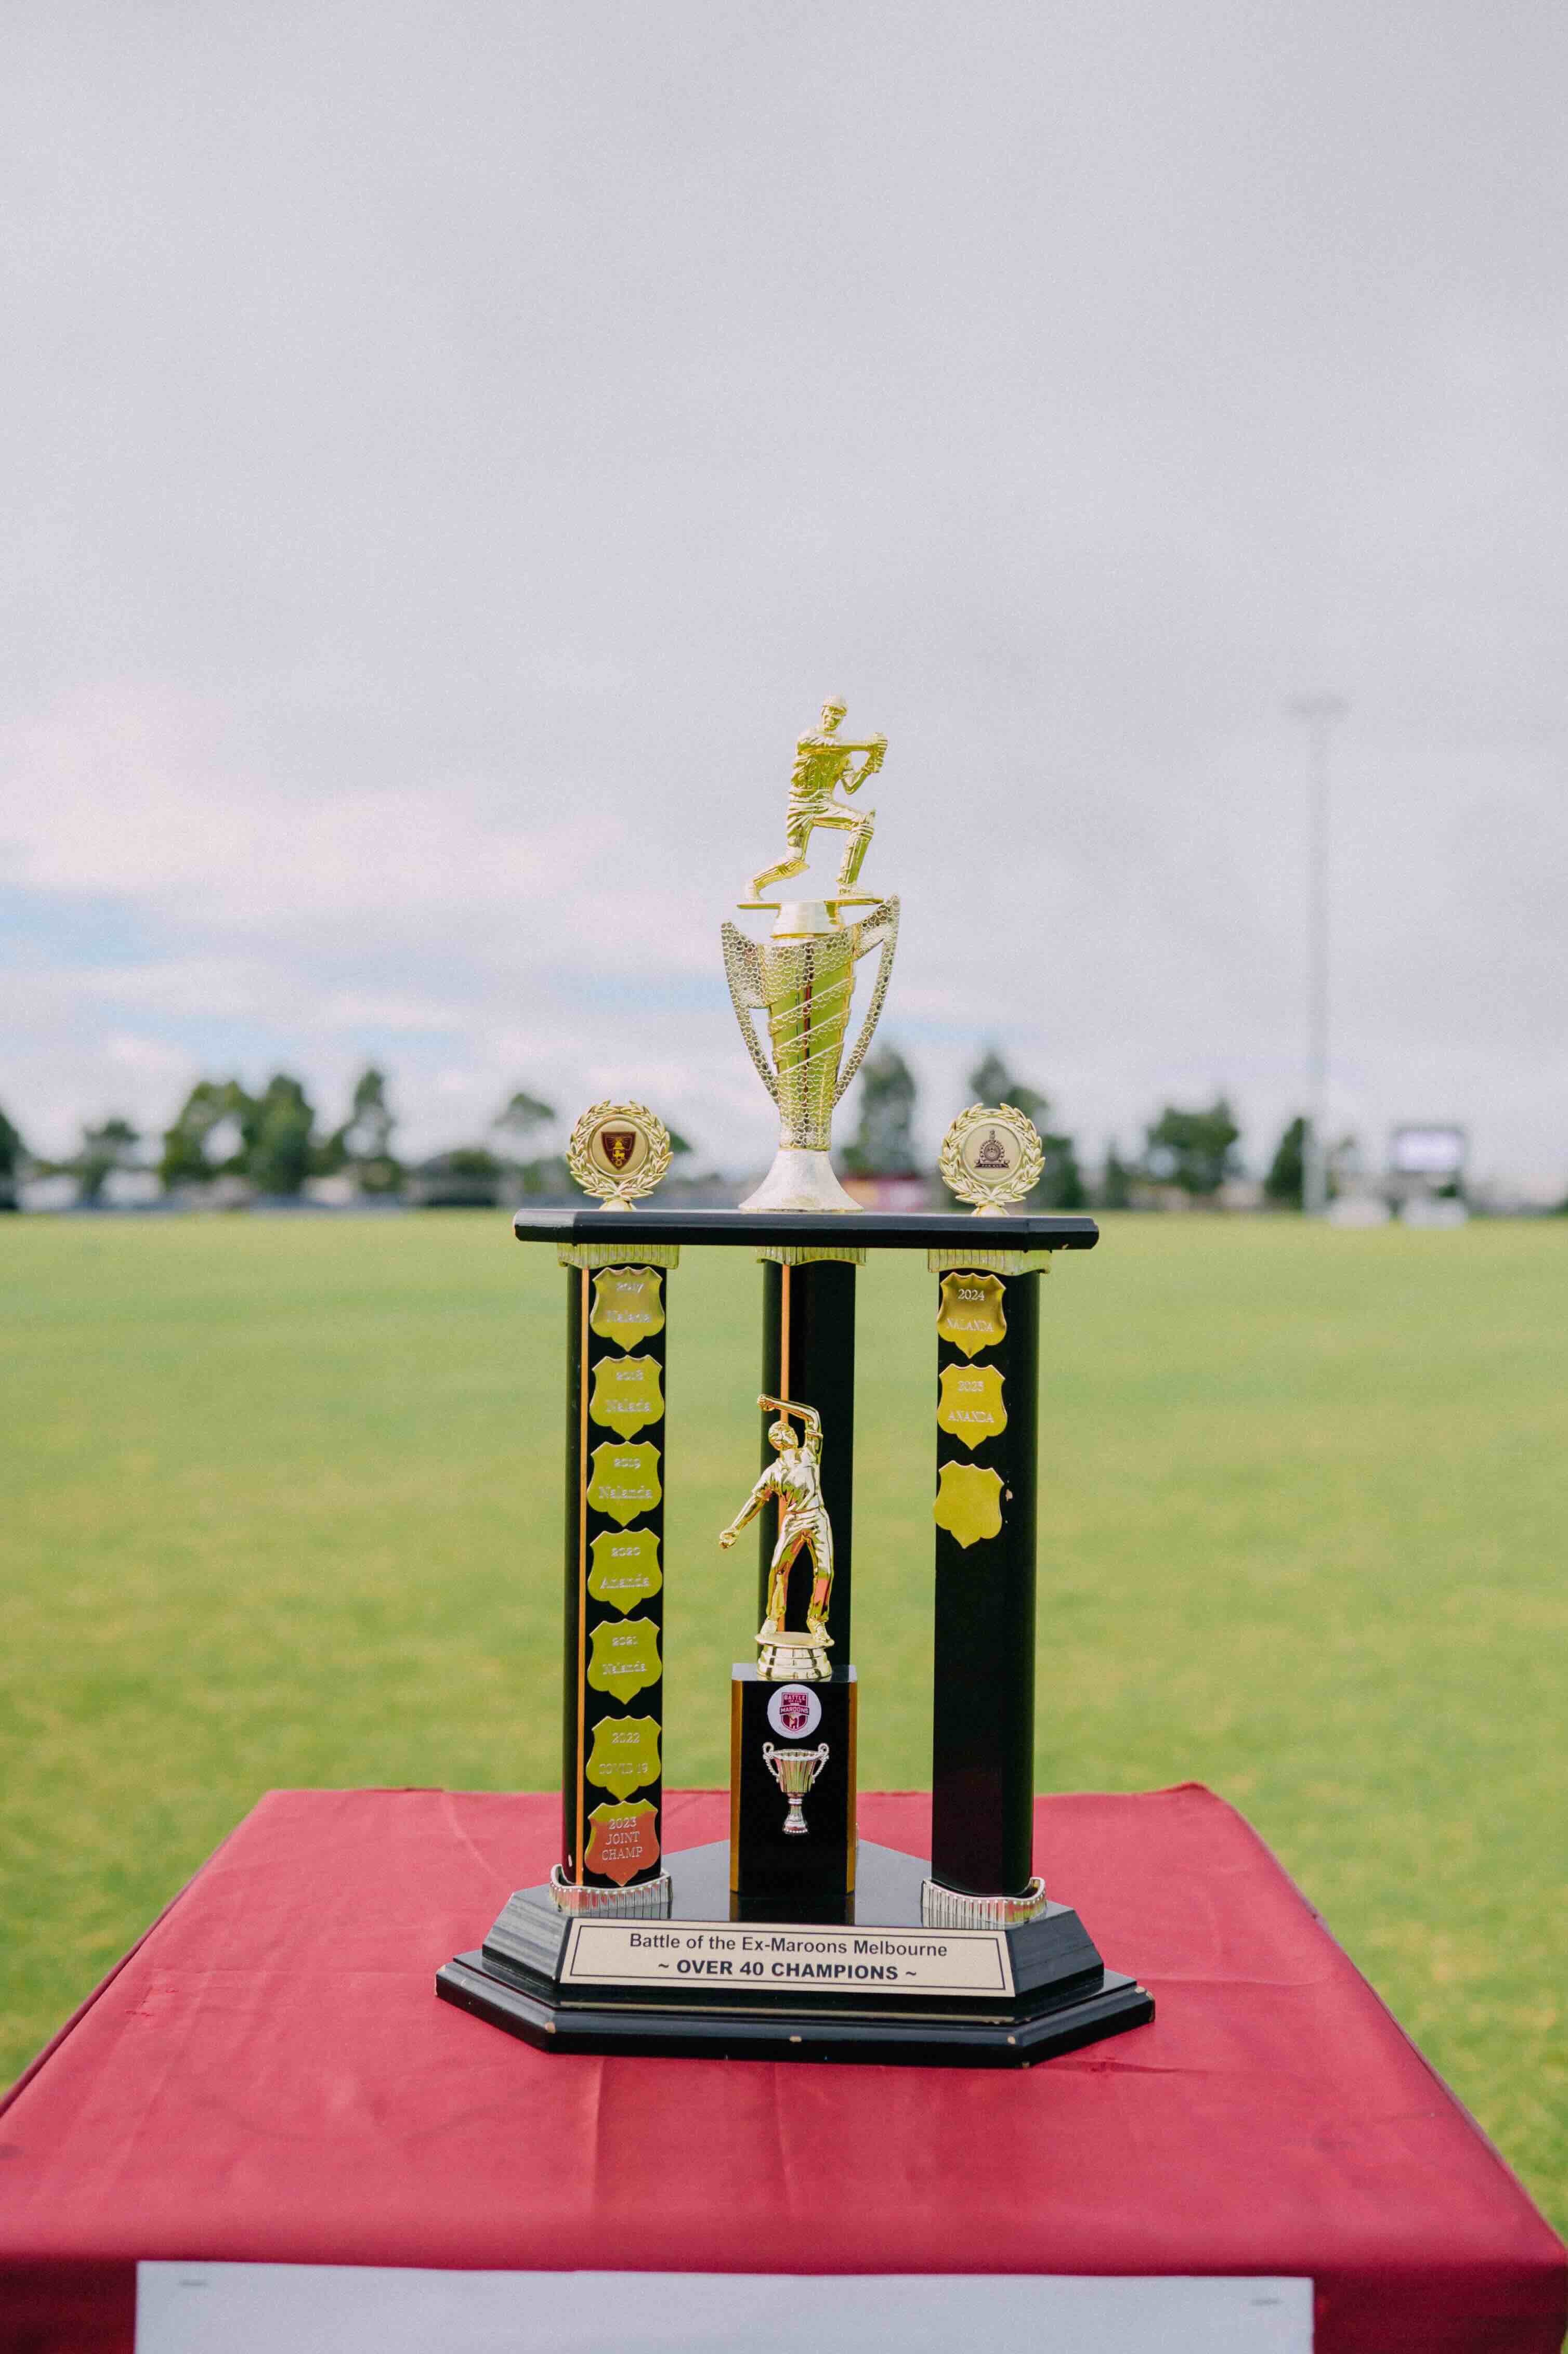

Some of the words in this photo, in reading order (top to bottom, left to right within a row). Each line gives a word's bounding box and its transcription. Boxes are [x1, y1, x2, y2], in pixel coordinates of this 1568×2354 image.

[958, 1288, 985, 1301] 2024
[947, 1317, 994, 1333] NALANDA
[948, 1409, 995, 1423] ANANDA
[611, 1732, 640, 1744] 2022
[609, 1816, 637, 1830] 2023
[605, 1830, 640, 1845] JOINT
[602, 1846, 643, 1861] CHAMP
[630, 1933, 680, 1948] Battle
[686, 1935, 703, 1949] of
[709, 1935, 736, 1950] the
[742, 1937, 847, 1954] Ex-Maroons
[854, 1940, 947, 1956] Melbourne
[676, 1959, 733, 1975] OVER
[740, 1961, 764, 1976] 40
[772, 1962, 898, 1980] CHAMPIONS
